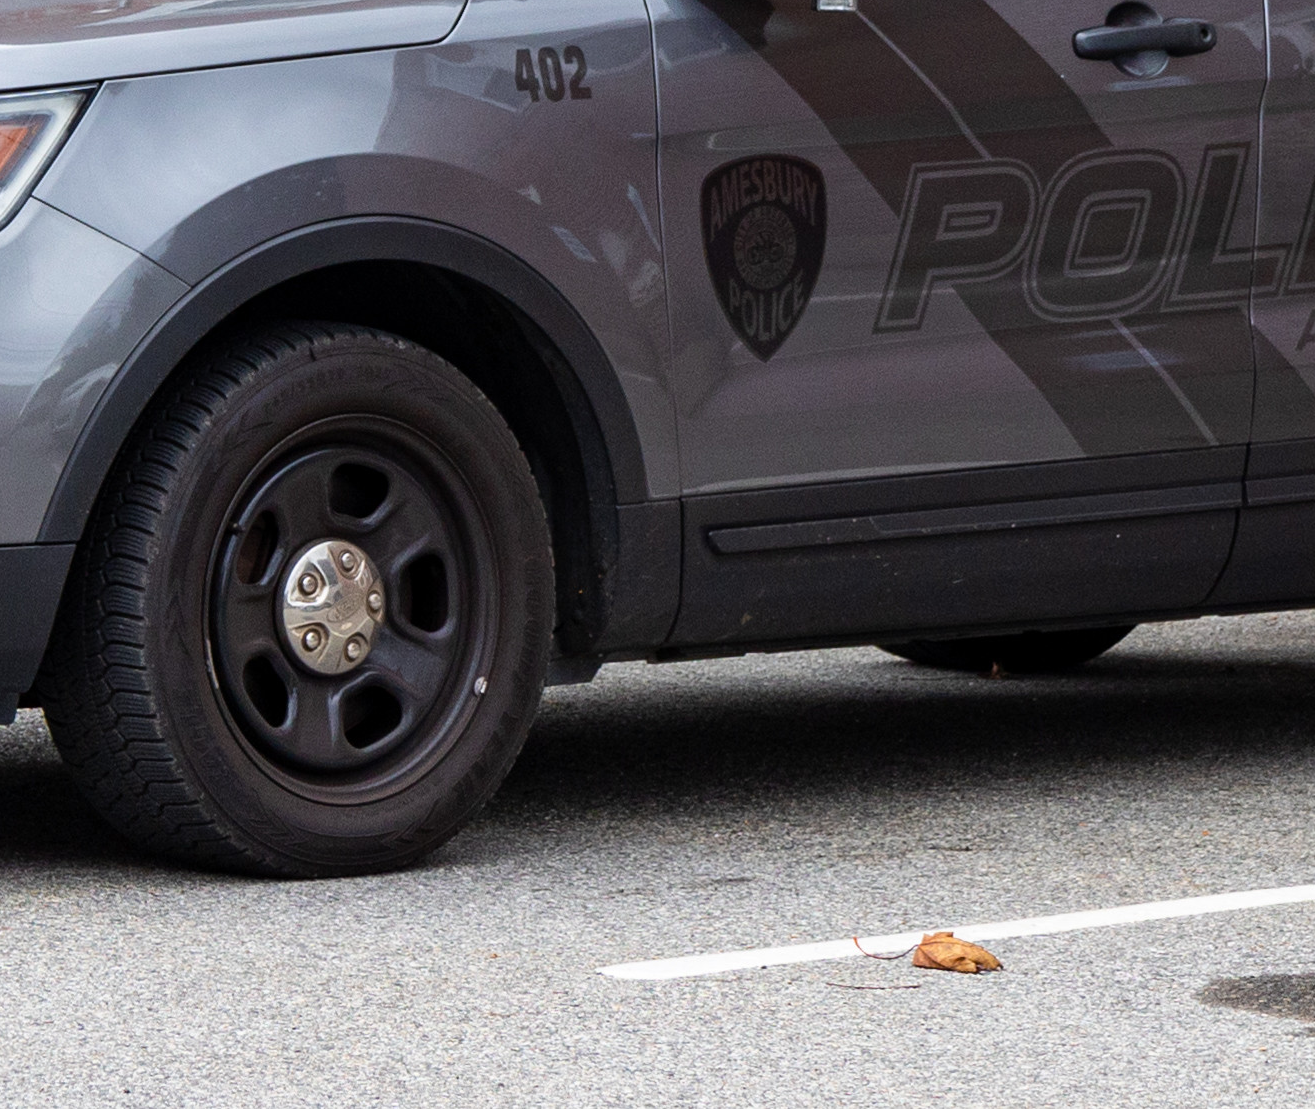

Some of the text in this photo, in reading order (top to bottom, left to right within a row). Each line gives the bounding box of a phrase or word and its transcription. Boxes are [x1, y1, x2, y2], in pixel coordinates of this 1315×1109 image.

[514, 45, 592, 103] 402
[710, 160, 818, 242] AMESBURY
[728, 268, 805, 341] POLICE
